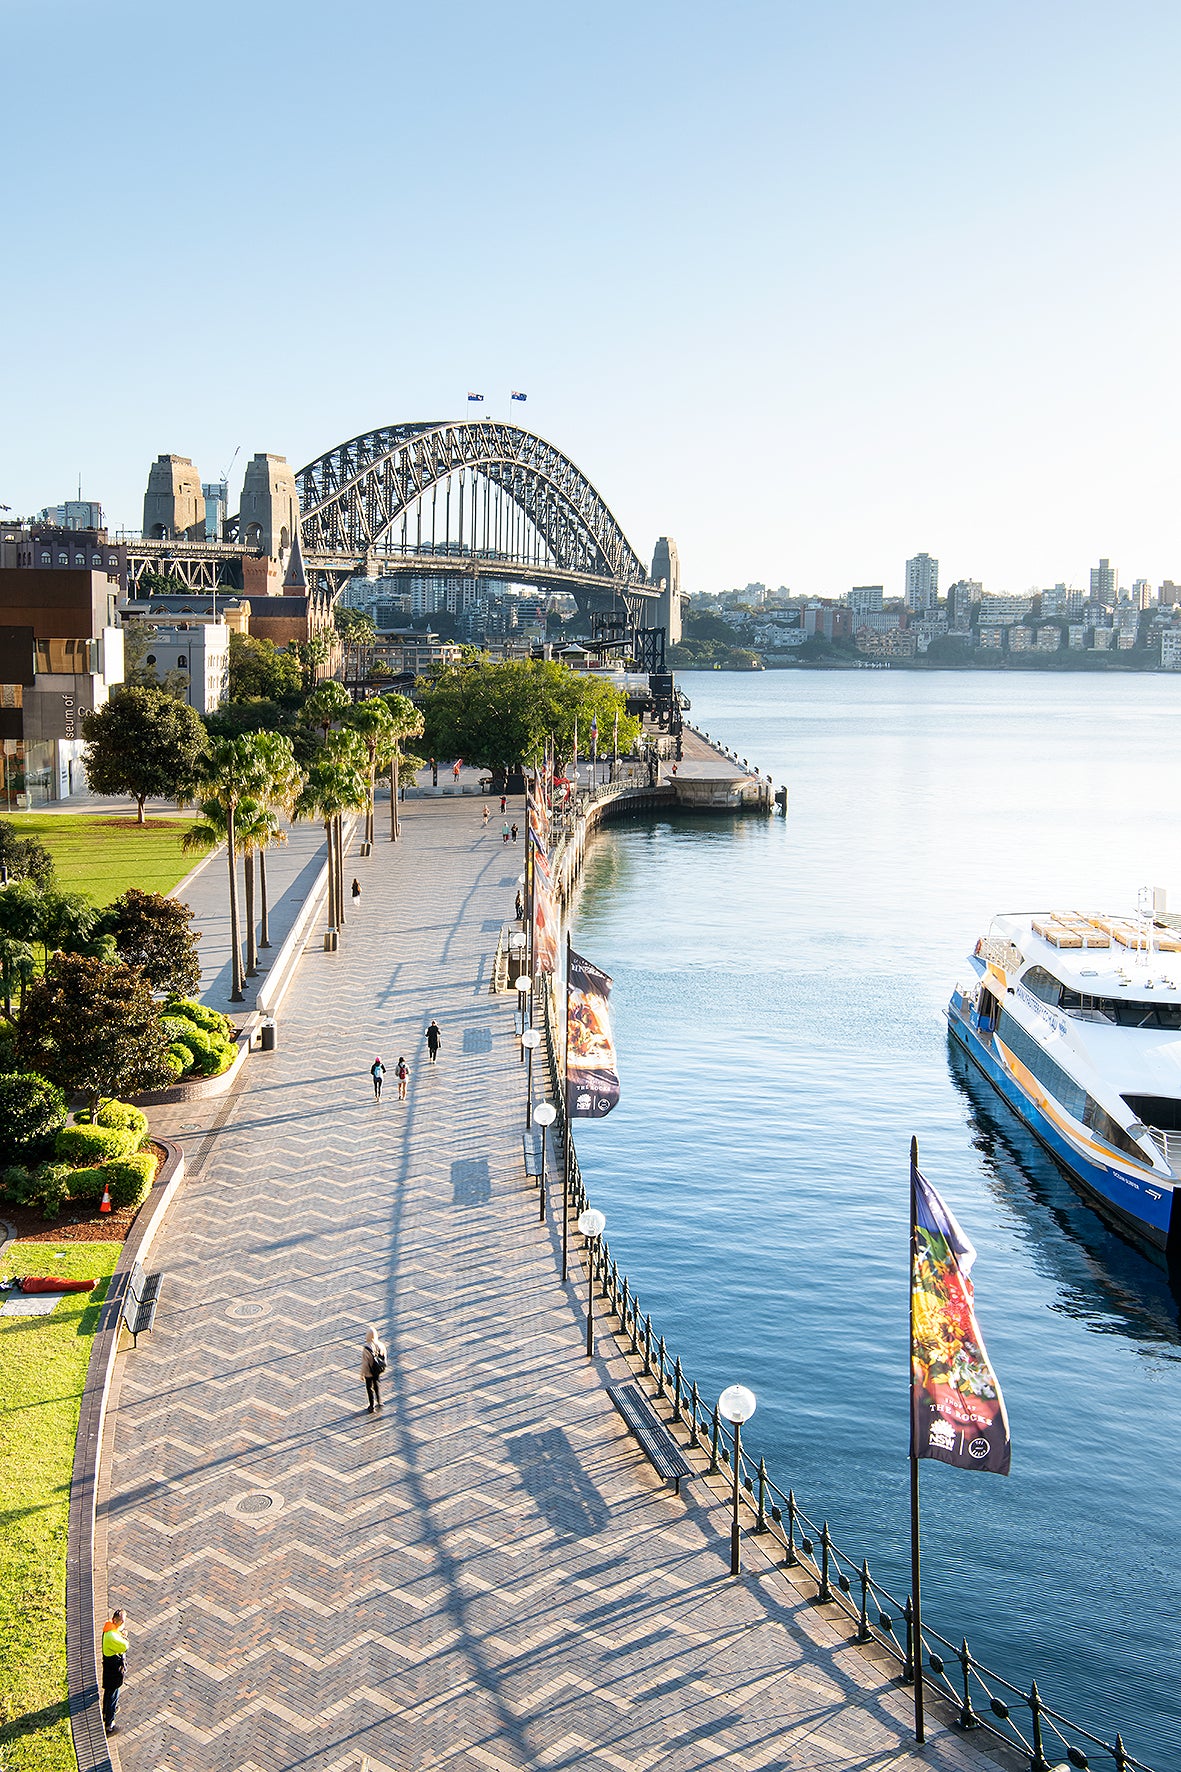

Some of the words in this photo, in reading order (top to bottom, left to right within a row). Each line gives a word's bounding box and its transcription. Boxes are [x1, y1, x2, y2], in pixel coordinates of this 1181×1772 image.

[62, 693, 74, 707] of
[77, 706, 93, 718] Co
[65, 709, 75, 739] seum
[929, 1403, 952, 1415] THE
[956, 1411, 993, 1426] ROCKS
[929, 1433, 955, 1448] NSW
